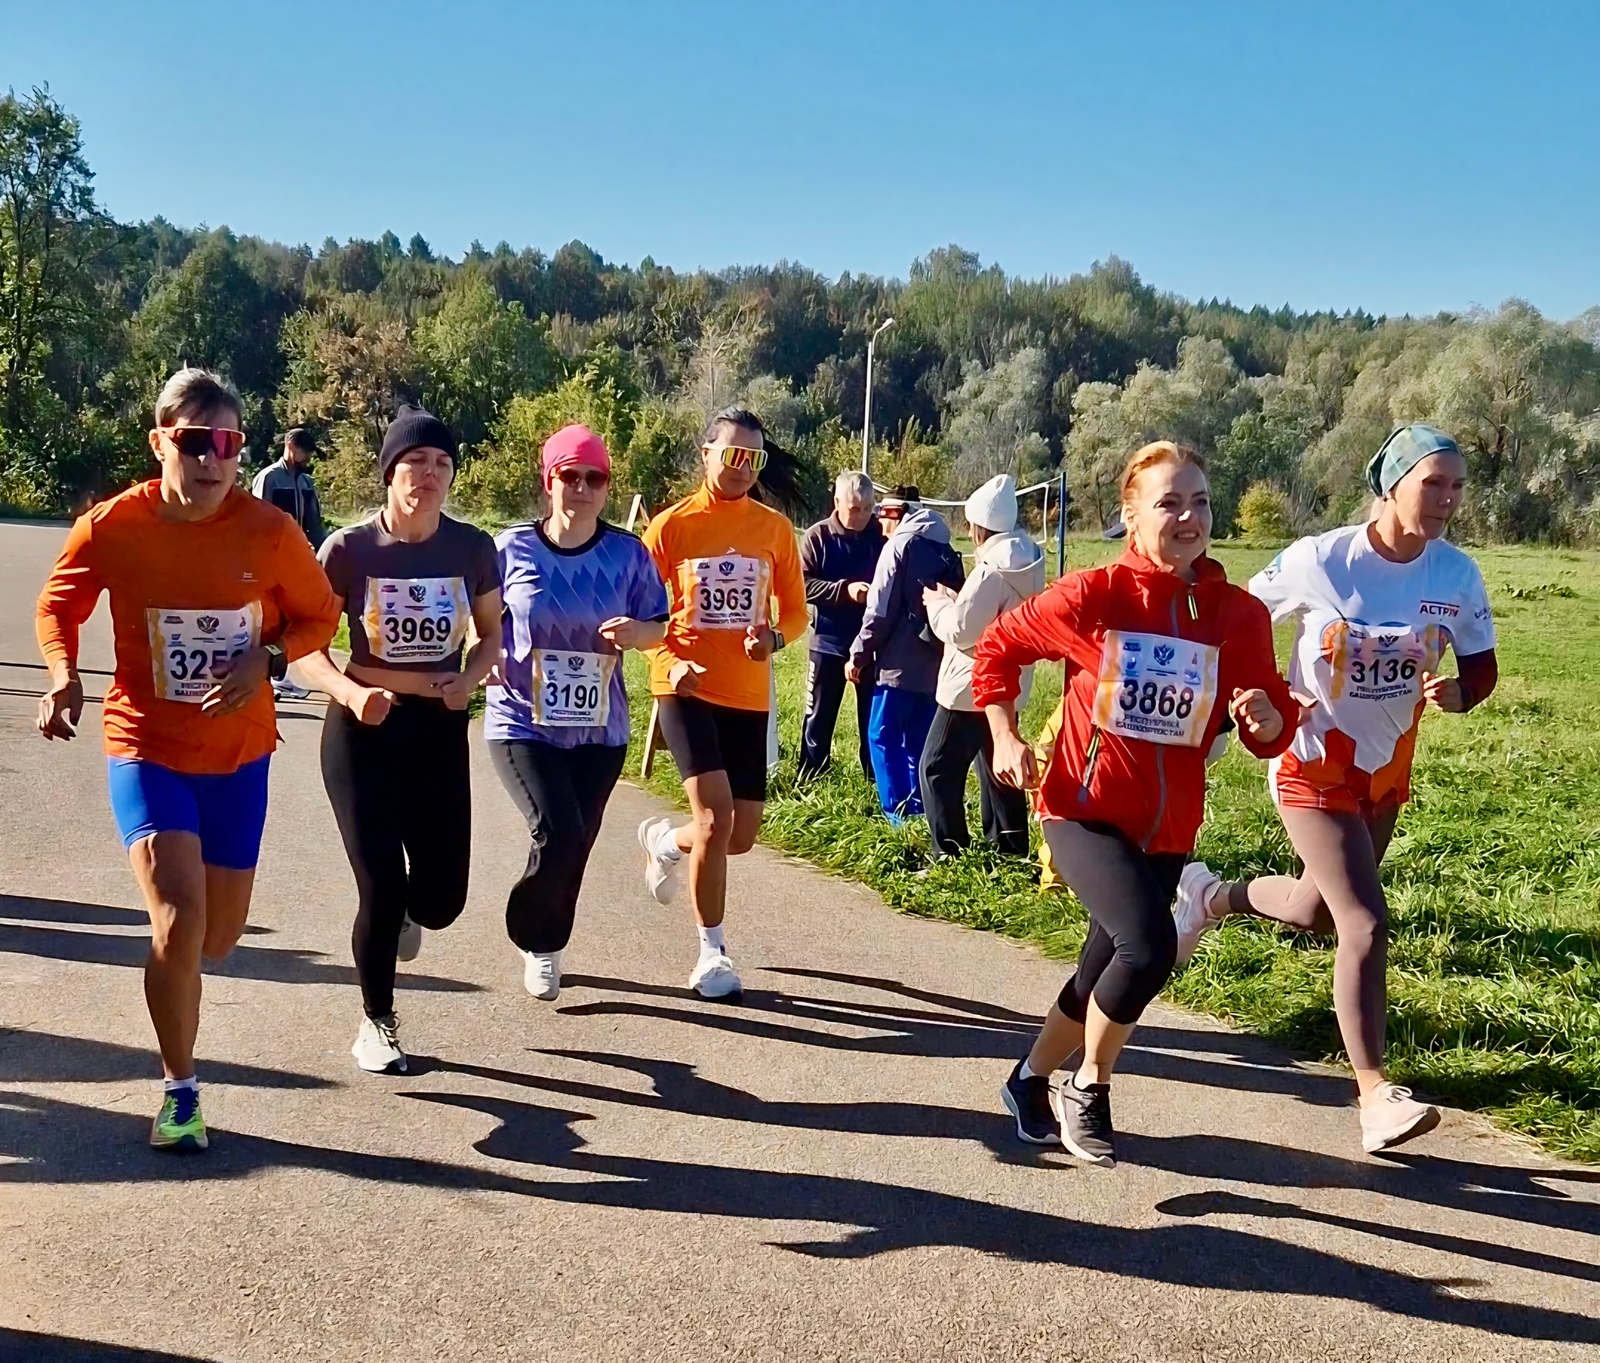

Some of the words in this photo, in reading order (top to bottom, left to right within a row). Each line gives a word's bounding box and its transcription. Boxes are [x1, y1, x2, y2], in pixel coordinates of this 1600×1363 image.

[700, 588, 752, 611] 3963
[384, 616, 451, 644] 3969
[169, 648, 244, 681] 325
[1350, 658, 1418, 686] 3136
[545, 682, 598, 709] 3190
[1119, 678, 1195, 720] 3868
